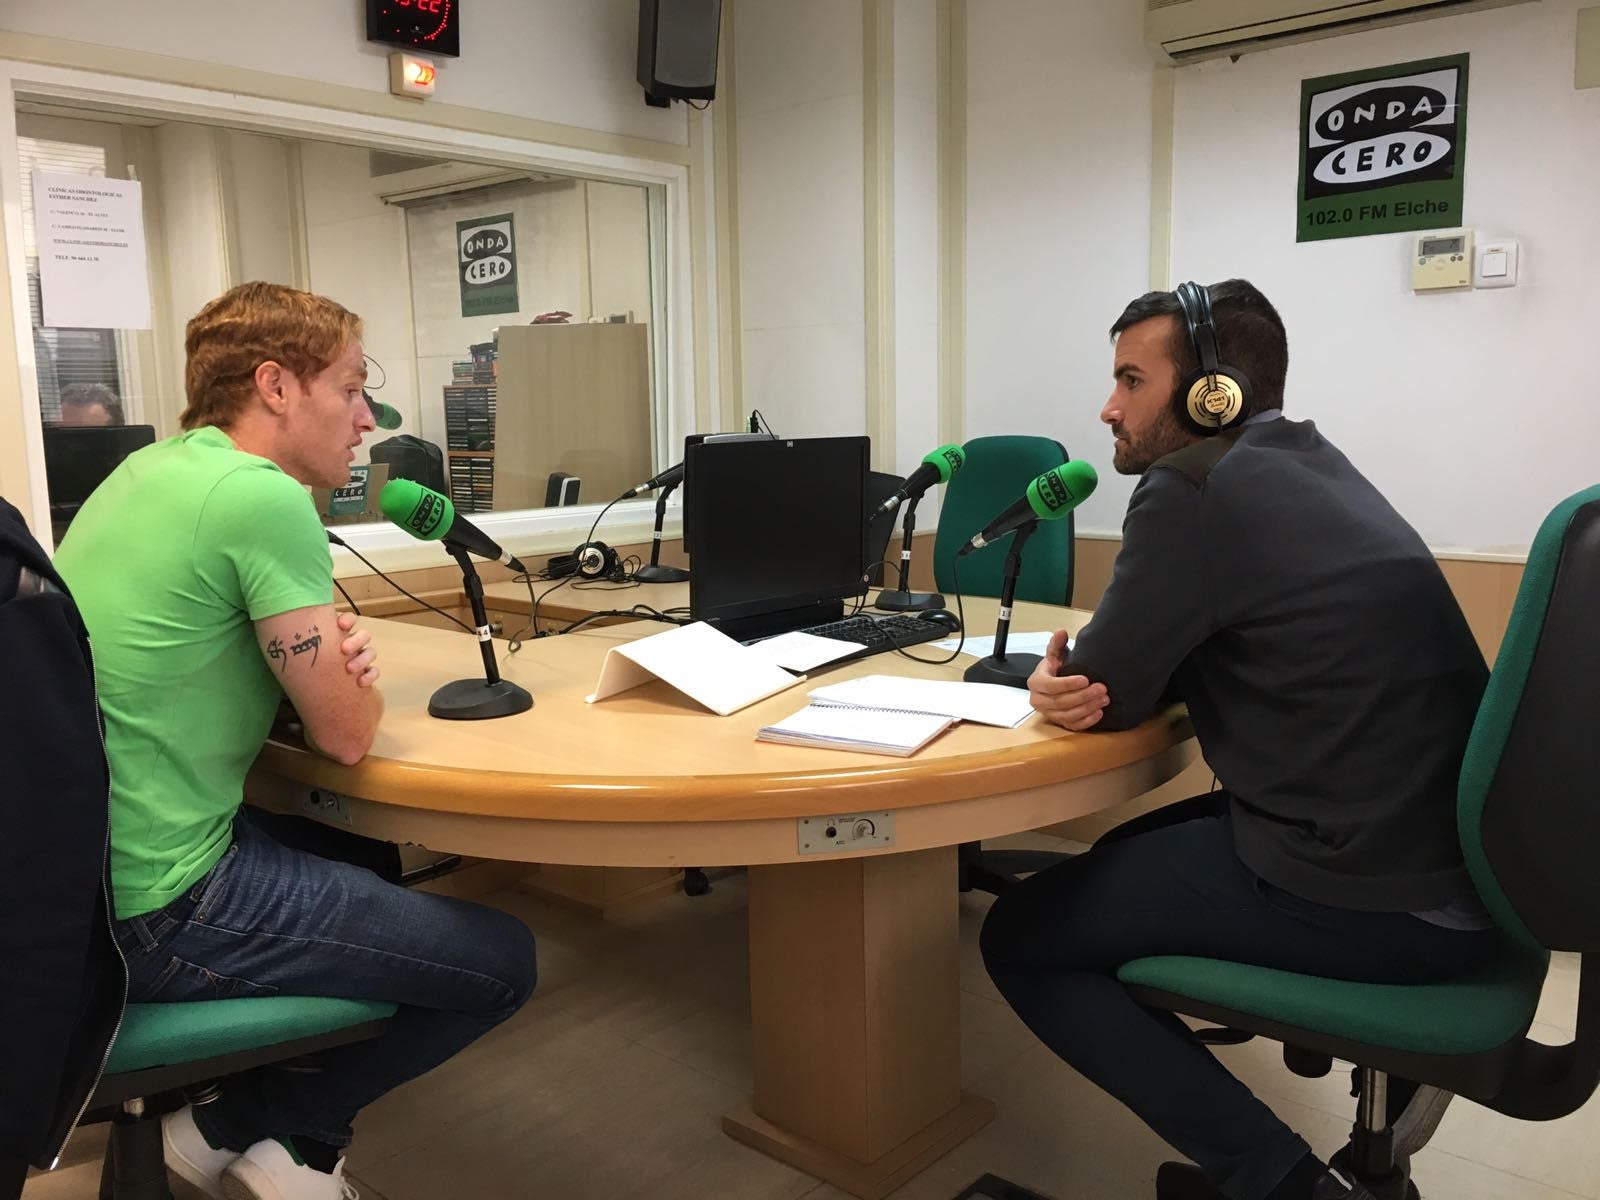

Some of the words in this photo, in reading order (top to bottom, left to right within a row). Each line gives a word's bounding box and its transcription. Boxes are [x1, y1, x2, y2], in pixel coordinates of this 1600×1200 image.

[1327, 96, 1433, 132] ONDA
[1331, 141, 1433, 176] CERO
[1306, 208, 1353, 226] 102.0
[1359, 204, 1387, 221] FM
[1394, 198, 1449, 217] Elche
[467, 236, 504, 254] ONDA
[470, 261, 506, 280] CERO
[335, 488, 363, 497] CERO
[1040, 478, 1057, 504] CERO
[424, 501, 441, 529] CERO
